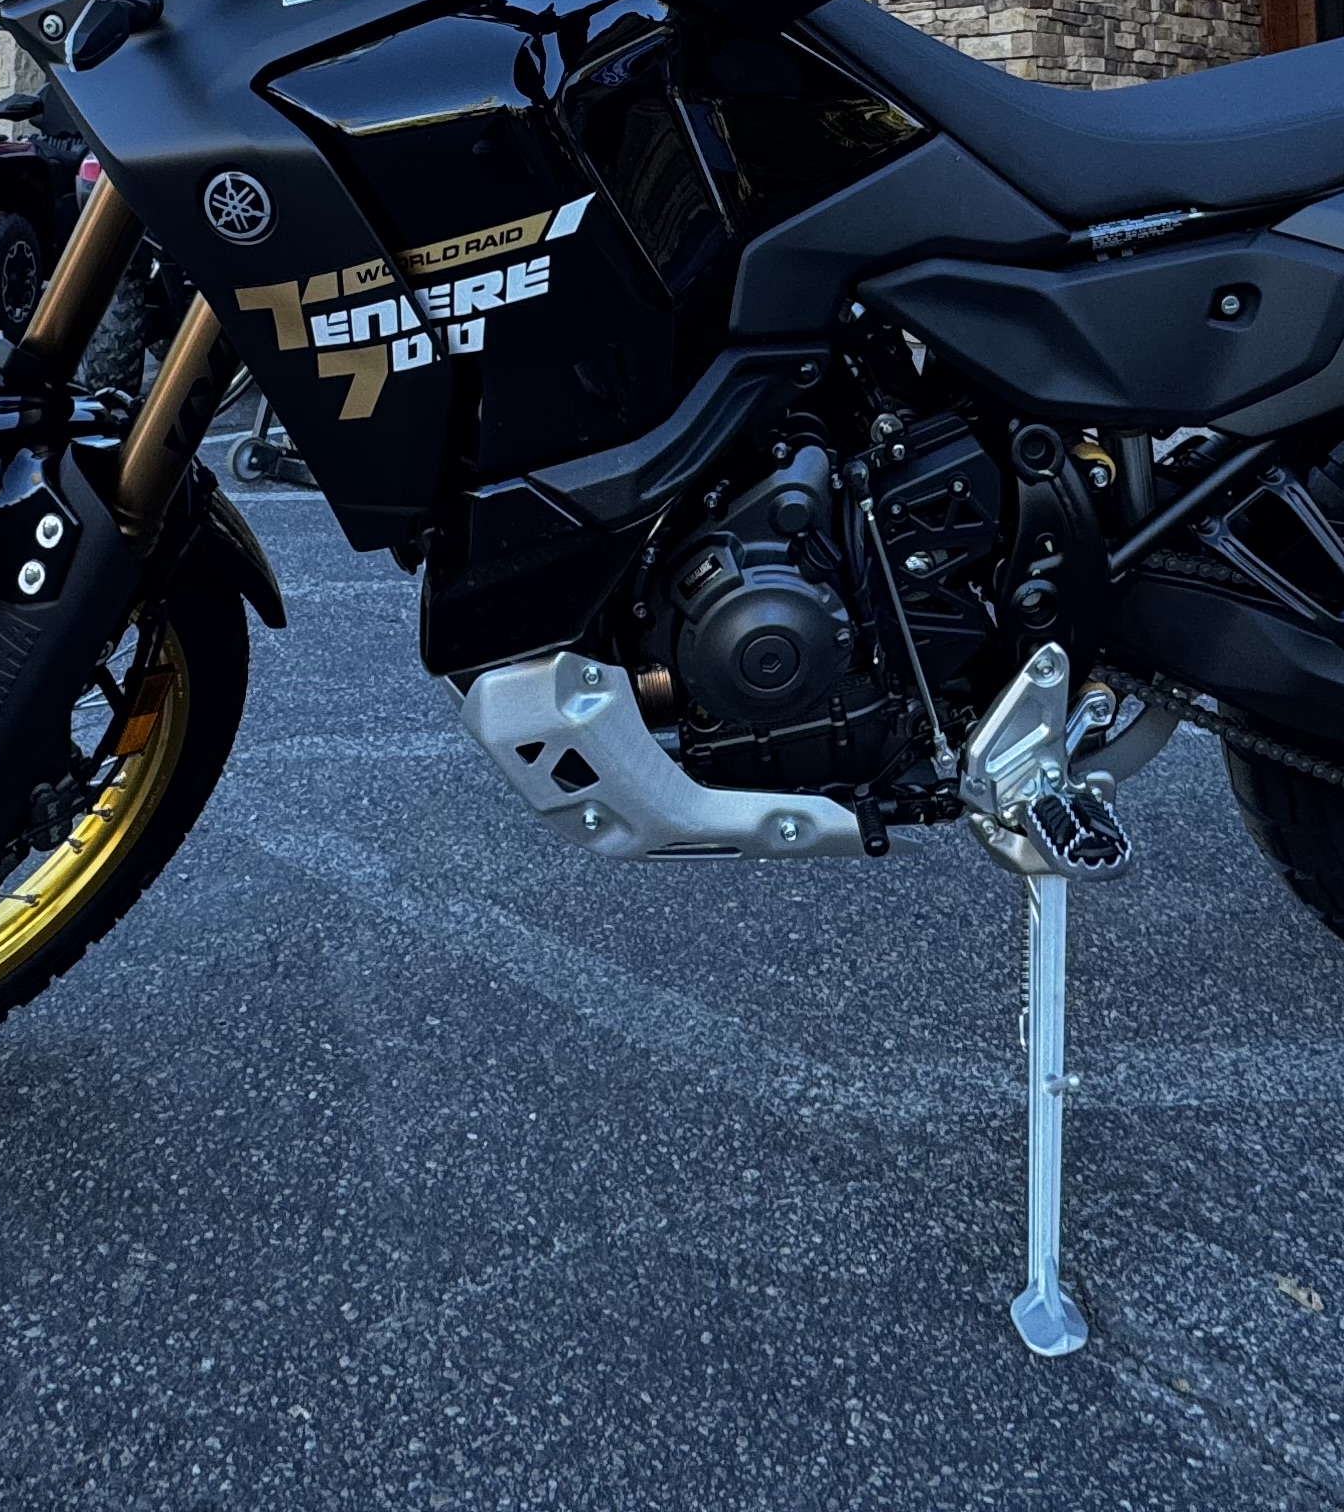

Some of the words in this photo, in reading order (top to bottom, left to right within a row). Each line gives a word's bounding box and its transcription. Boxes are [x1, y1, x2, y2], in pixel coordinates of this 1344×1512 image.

[356, 244, 460, 285] WORLD
[464, 226, 524, 256] RAID
[317, 317, 485, 420] 700
